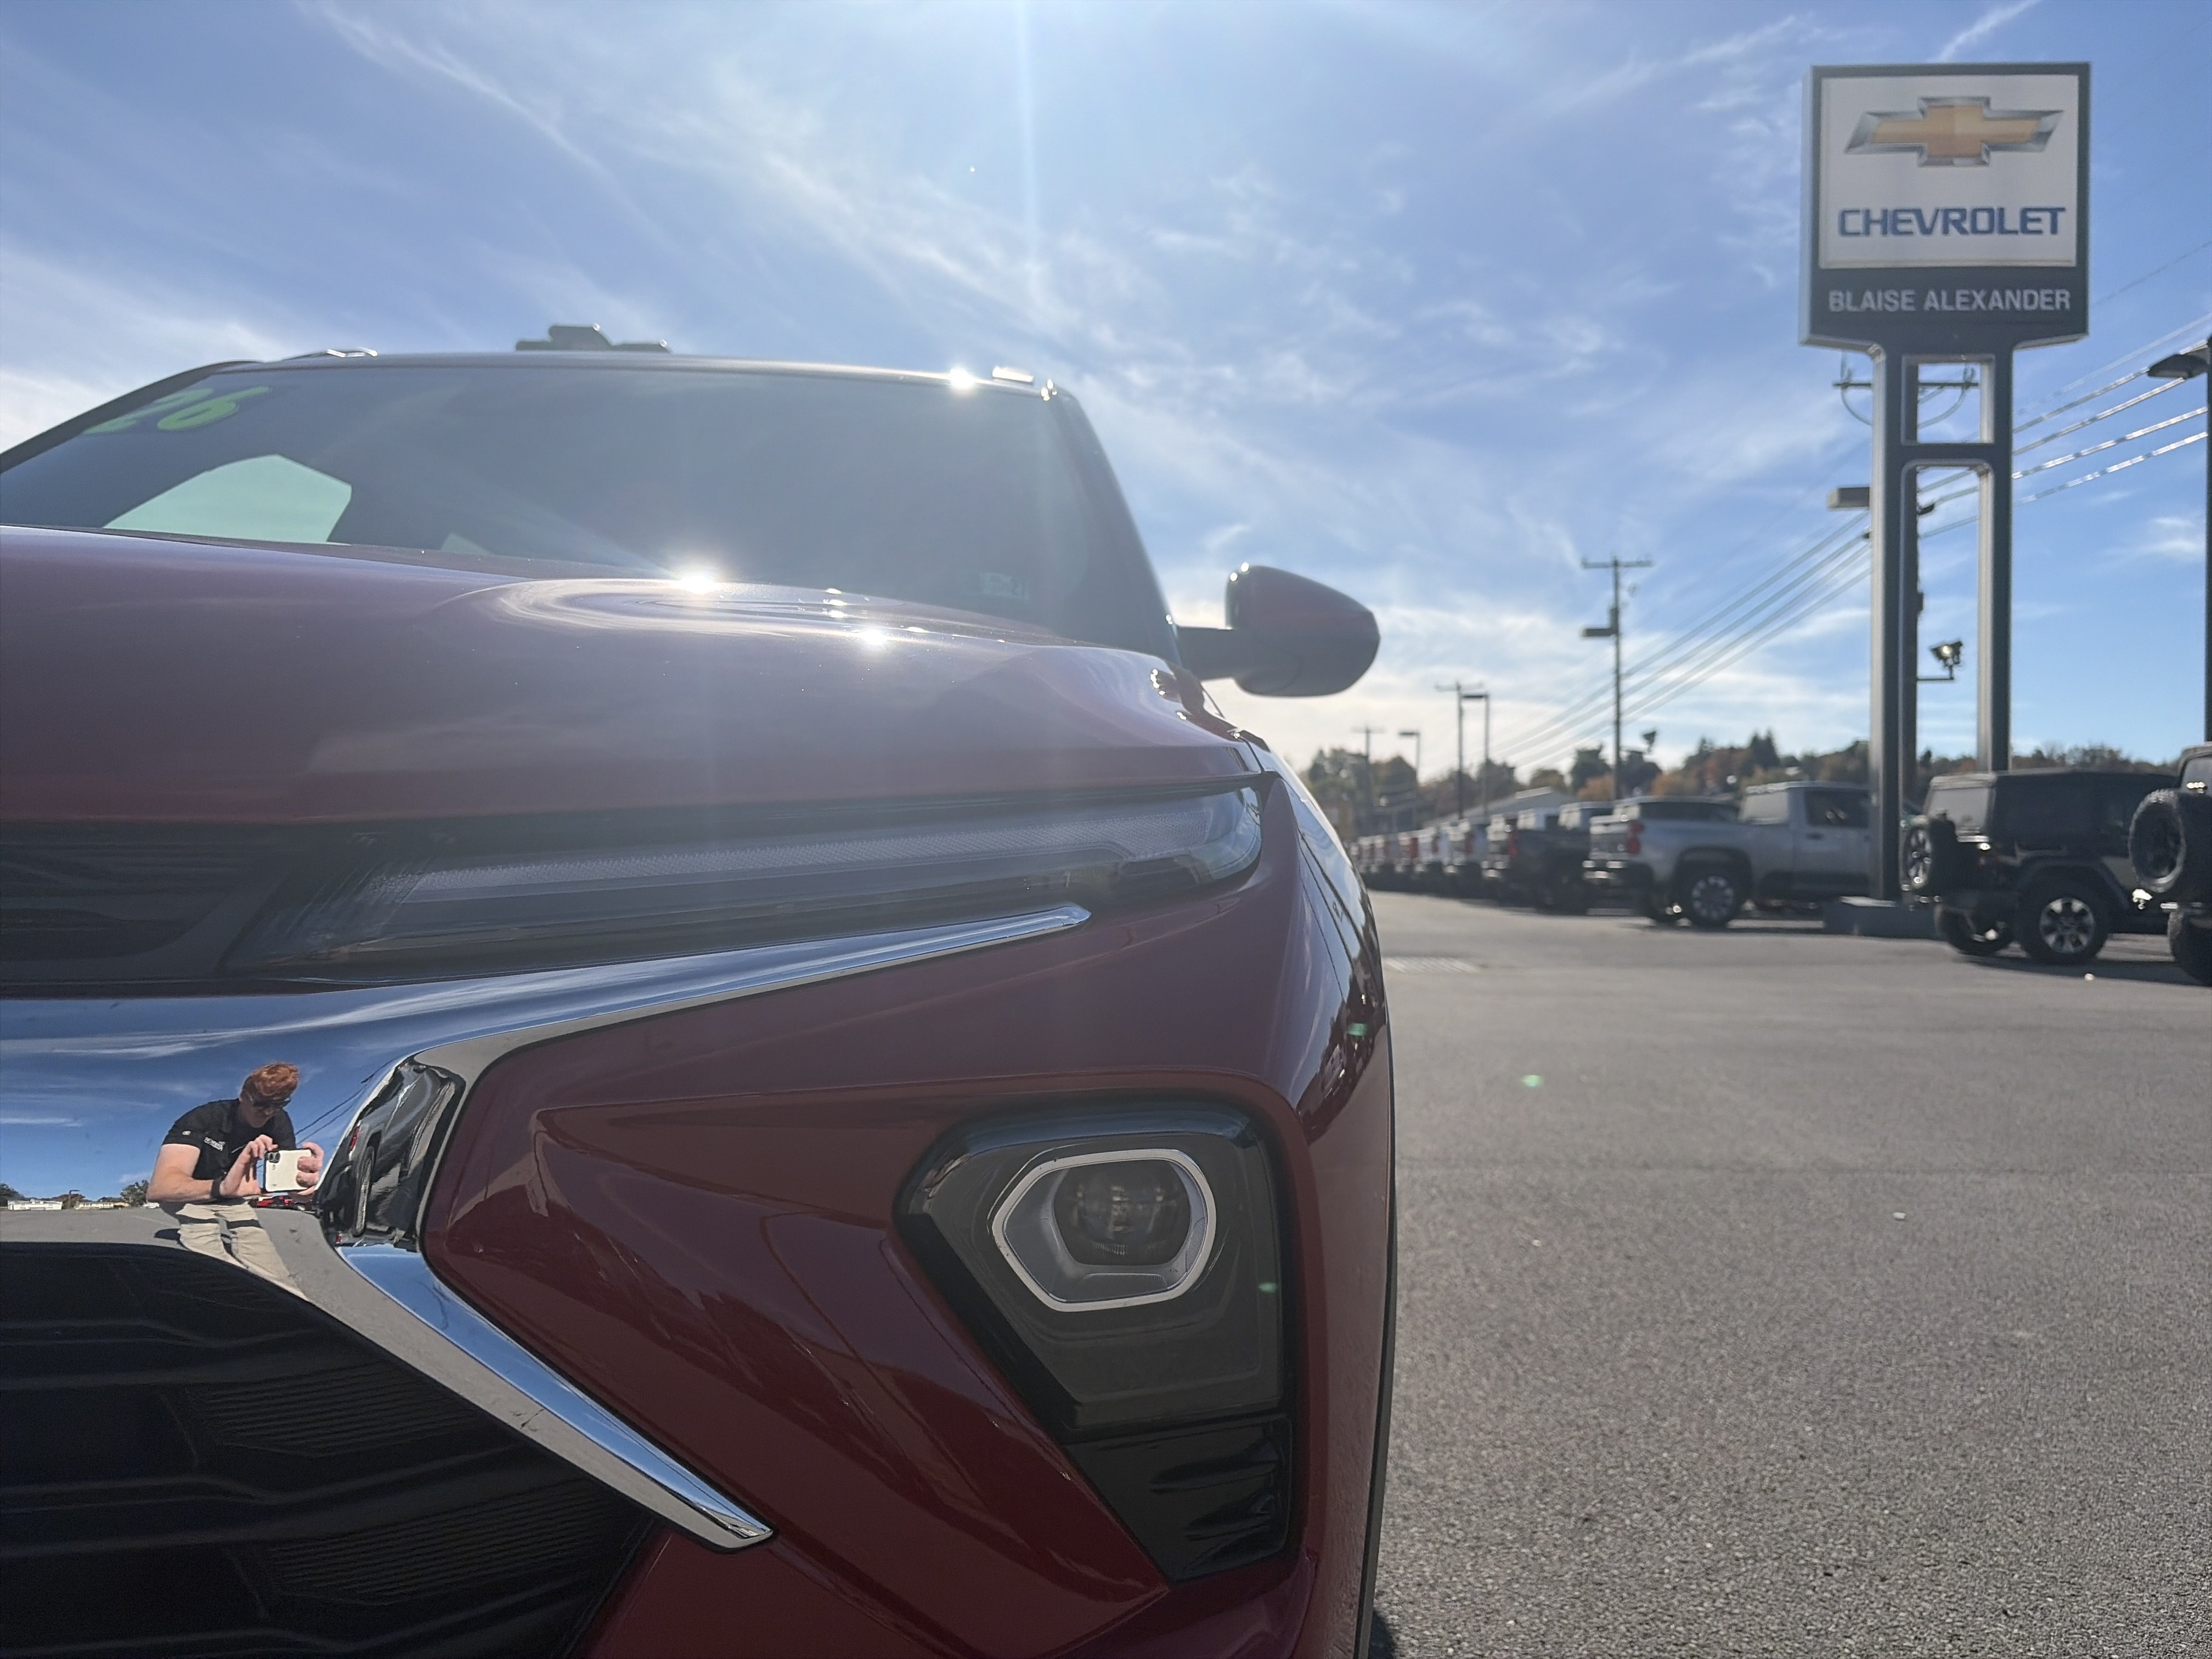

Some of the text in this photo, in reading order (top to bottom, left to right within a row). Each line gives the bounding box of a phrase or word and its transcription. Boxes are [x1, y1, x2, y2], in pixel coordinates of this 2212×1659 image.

[1838, 207, 2066, 236] CHEVROLET
[1829, 289, 2071, 312] BLAISE ALEXANDER
